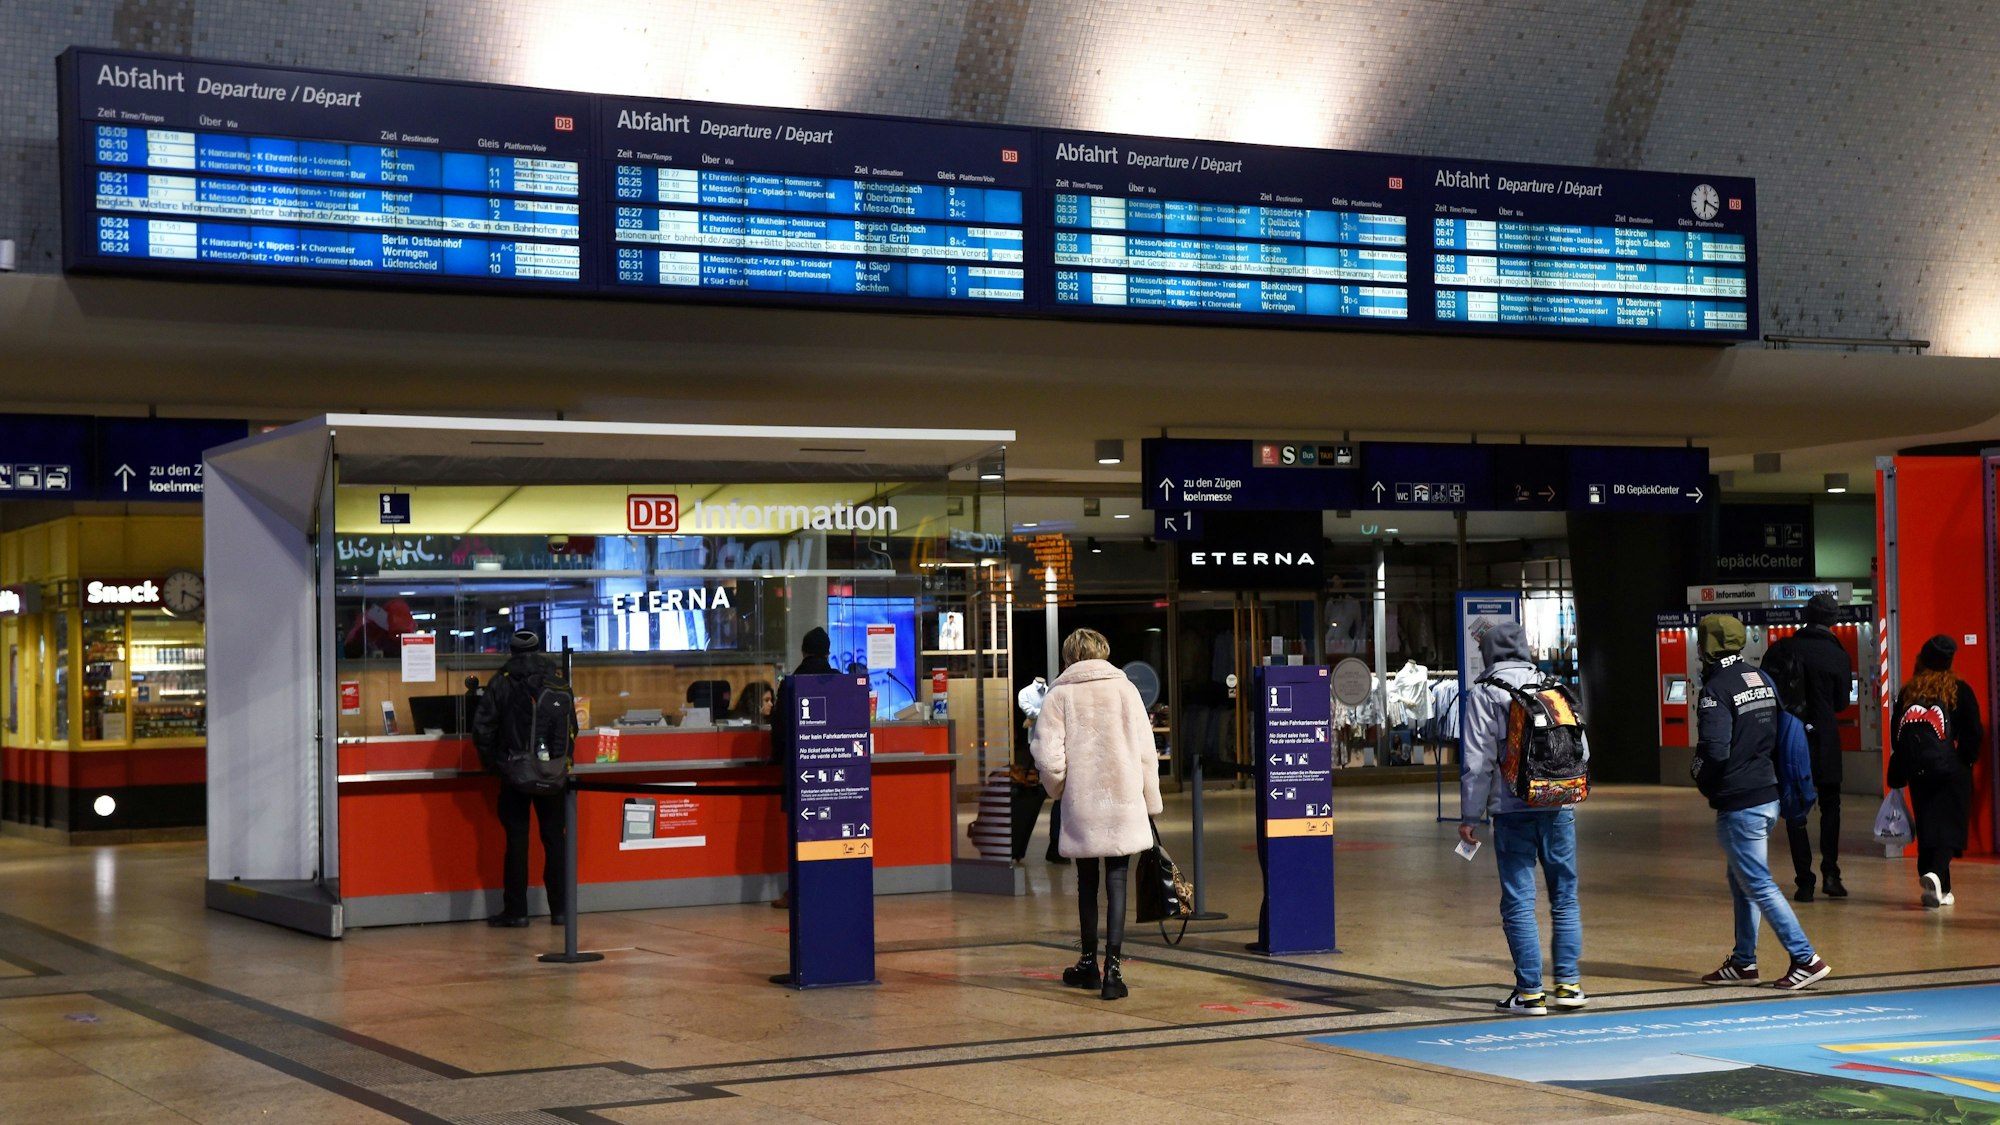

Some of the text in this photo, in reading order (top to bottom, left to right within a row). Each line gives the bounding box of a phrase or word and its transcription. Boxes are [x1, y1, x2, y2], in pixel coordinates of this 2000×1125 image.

[97, 64, 361, 108] Abfahrt Departure / Départ
[97, 108, 164, 122] Zeit Time/Temps
[199, 115, 238, 128] Über Via
[556, 118, 572, 129] DB
[99, 127, 128, 137] 06:09
[617, 109, 833, 145] Abfahrt Departure / Départ
[381, 131, 439, 144] Ziel Destination
[99, 140, 128, 150] 06:10
[478, 139, 547, 152] Gleis Platform/Voie
[99, 152, 129, 162] 06:20
[381, 148, 398, 158] Kiel
[617, 150, 672, 161] Zeit Time/Temps
[1003, 151, 1017, 162] DB
[1056, 142, 1242, 174] Abfahrt Departure / Départ
[702, 154, 720, 164] Über
[381, 161, 415, 171] Horrem
[618, 166, 642, 175] 06:25
[855, 166, 903, 176] Ziel Destination
[381, 171, 408, 182] Düren
[618, 177, 642, 186] 06:25
[938, 171, 995, 182] Gleis Platform/Voie
[854, 181, 922, 194] Mönchengladbach
[1056, 179, 1103, 190] Zeit Time/Temps
[1129, 182, 1144, 192] Über
[1389, 178, 1402, 189] DB
[1435, 170, 1602, 197] Abfahrt Departure / Départ
[382, 191, 413, 202] Hennef
[618, 189, 642, 197] 06:27
[1260, 193, 1272, 201] Ziel
[1056, 195, 1077, 203] 06:33
[1332, 198, 1348, 206] Gleis
[382, 203, 410, 214] Hagen
[1057, 205, 1077, 213] 06:35
[1435, 204, 1477, 214] Zeit Time/Temps
[1730, 200, 1741, 209] DB
[1499, 207, 1513, 216] Über
[100, 218, 129, 228] 06:24
[1057, 216, 1077, 224] 06:37
[1615, 214, 1626, 222] Ziel
[1678, 218, 1693, 226] Gleis
[855, 221, 926, 234] Bergisch Gladbach
[1615, 228, 1647, 237] Euskirchen
[382, 234, 462, 248] Berlin Ostbahnhof
[855, 232, 909, 243] Bedburg (Erft)
[1616, 238, 1670, 248] Bergisch Gladbach
[382, 247, 428, 259] Worringen
[619, 249, 642, 258] 06:31
[1261, 244, 1281, 253] Essen
[1616, 247, 1638, 256] Aachen
[382, 258, 437, 270] Lüdenscheid
[1261, 255, 1288, 263] Koblenz
[856, 261, 890, 272] Au (Sieg)
[856, 272, 880, 282] Wesel
[1261, 281, 1302, 293] Blankenberg
[1261, 292, 1287, 300] Krefeld
[1262, 302, 1295, 312] Worringen
[1617, 317, 1634, 325] Basel
[1282, 446, 1295, 464] S
[1302, 451, 1314, 459] Bus
[150, 466, 163, 476] zu
[167, 465, 190, 476] den
[1184, 478, 1241, 490] zu den Zügen
[1614, 485, 1679, 495] DB GepäckCenter
[1184, 492, 1232, 501] koelnmesse
[631, 498, 897, 530] DB Information
[1183, 511, 1192, 530] 1
[1192, 553, 1315, 565] ETERNA
[1716, 554, 1803, 570] epäckCenter
[88, 580, 159, 603] Snack
[1702, 589, 1755, 599] DB Information
[1784, 587, 1795, 597] DB
[613, 586, 730, 615] ETERNA
[1418, 1033, 1556, 1046] Vielfalt
[1548, 1025, 1641, 1035] liegt
[1682, 1014, 1809, 1026] unserer
[1802, 1006, 1914, 1017] DNA.
